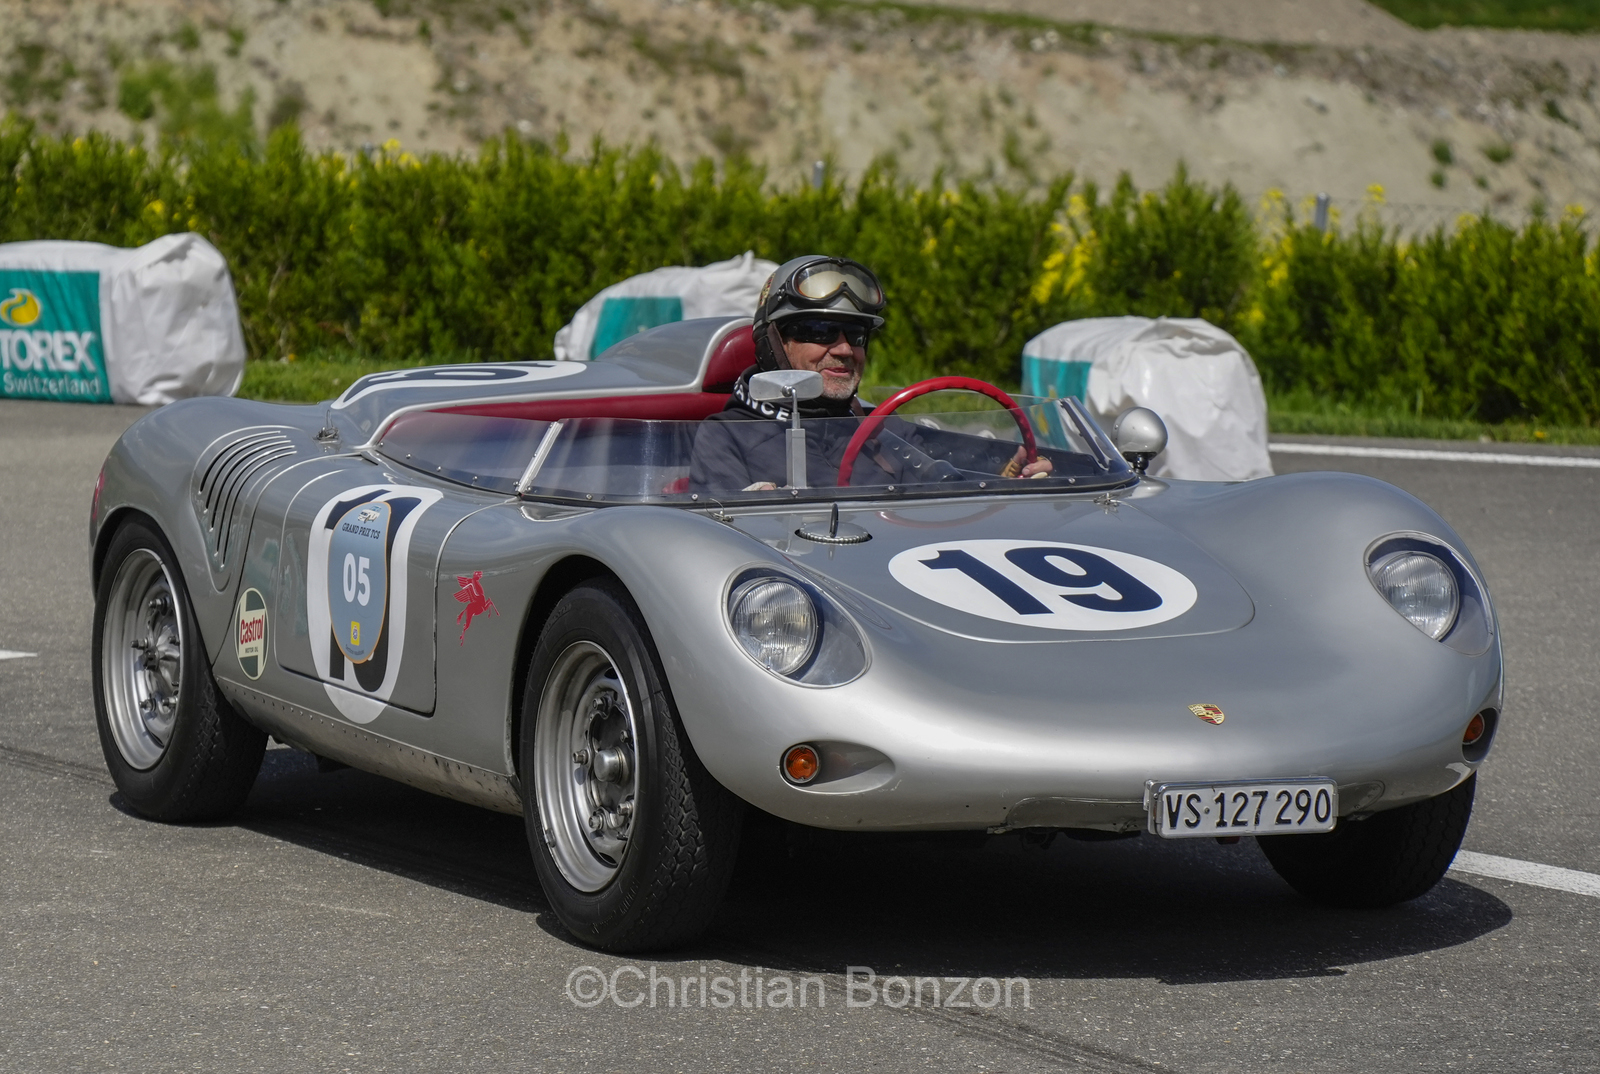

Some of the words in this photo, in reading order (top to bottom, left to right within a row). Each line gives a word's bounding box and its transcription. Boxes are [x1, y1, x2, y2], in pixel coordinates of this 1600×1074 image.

[0, 329, 96, 372] TOREX
[3, 371, 100, 395] Switzerland
[342, 522, 360, 534] GRAND
[358, 526, 372, 537] PRIX
[370, 529, 381, 540] TCS
[343, 552, 371, 607] 05
[917, 546, 1163, 616] 19
[240, 614, 264, 645] Castrol
